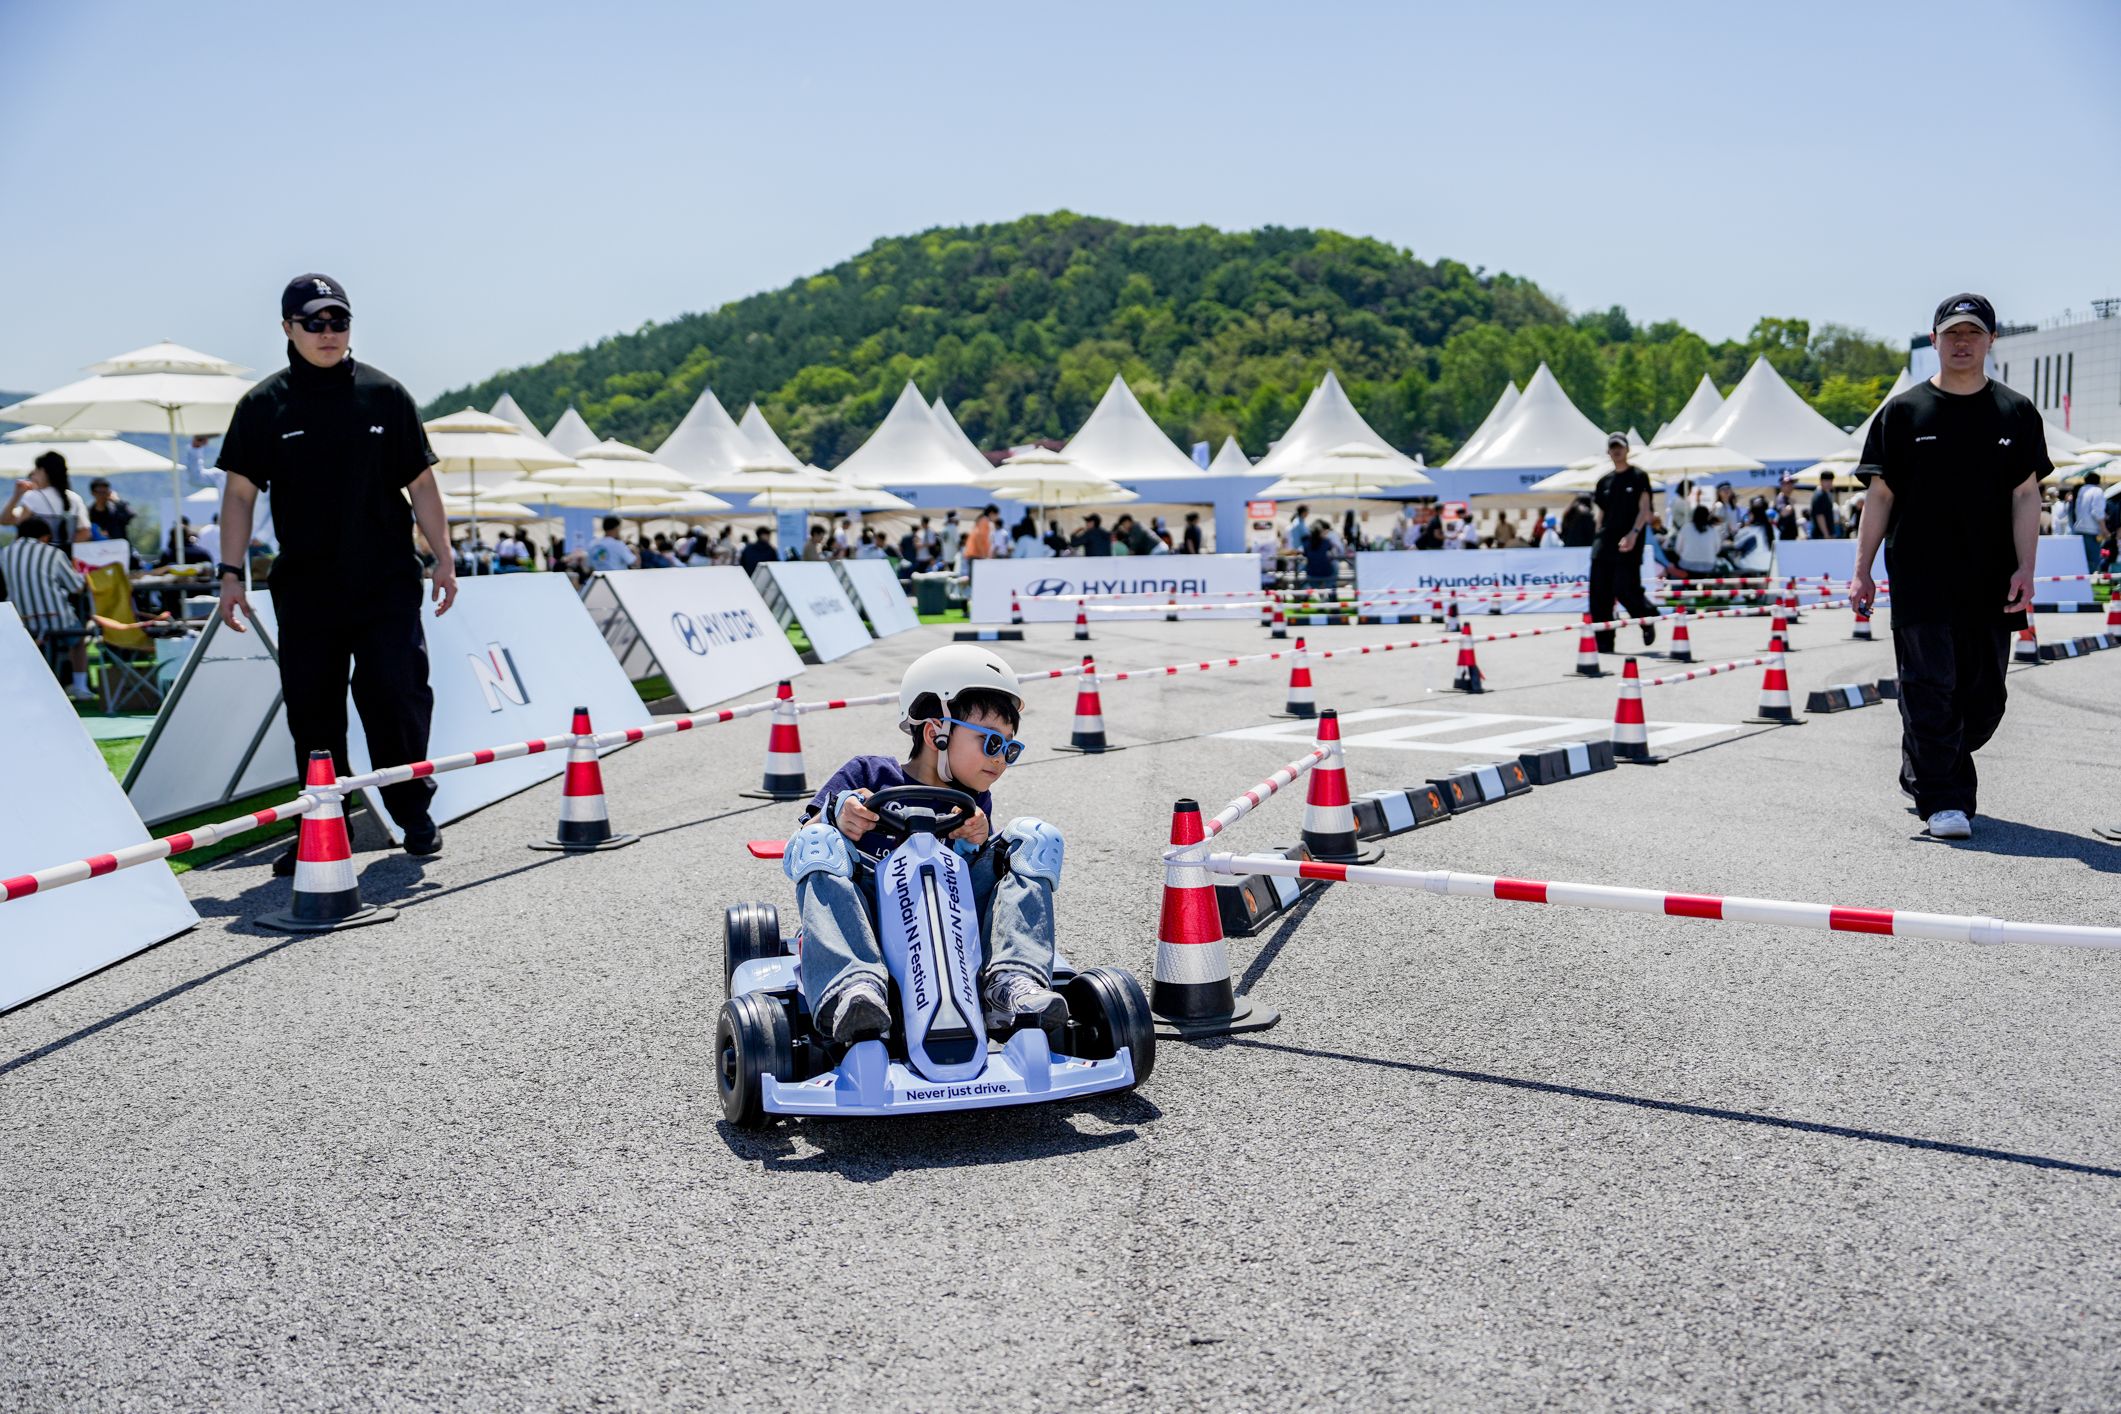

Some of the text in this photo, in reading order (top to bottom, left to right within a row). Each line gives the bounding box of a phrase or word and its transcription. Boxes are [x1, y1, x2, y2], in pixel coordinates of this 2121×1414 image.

[313, 279, 332, 295] LA
[1502, 574, 1517, 587] N
[1522, 571, 1590, 587] Festiva
[892, 855, 929, 1011] Hyundai N Festival
[939, 851, 974, 1005] Hyundai N Festival
[906, 1083, 1011, 1101] Never just drive.
